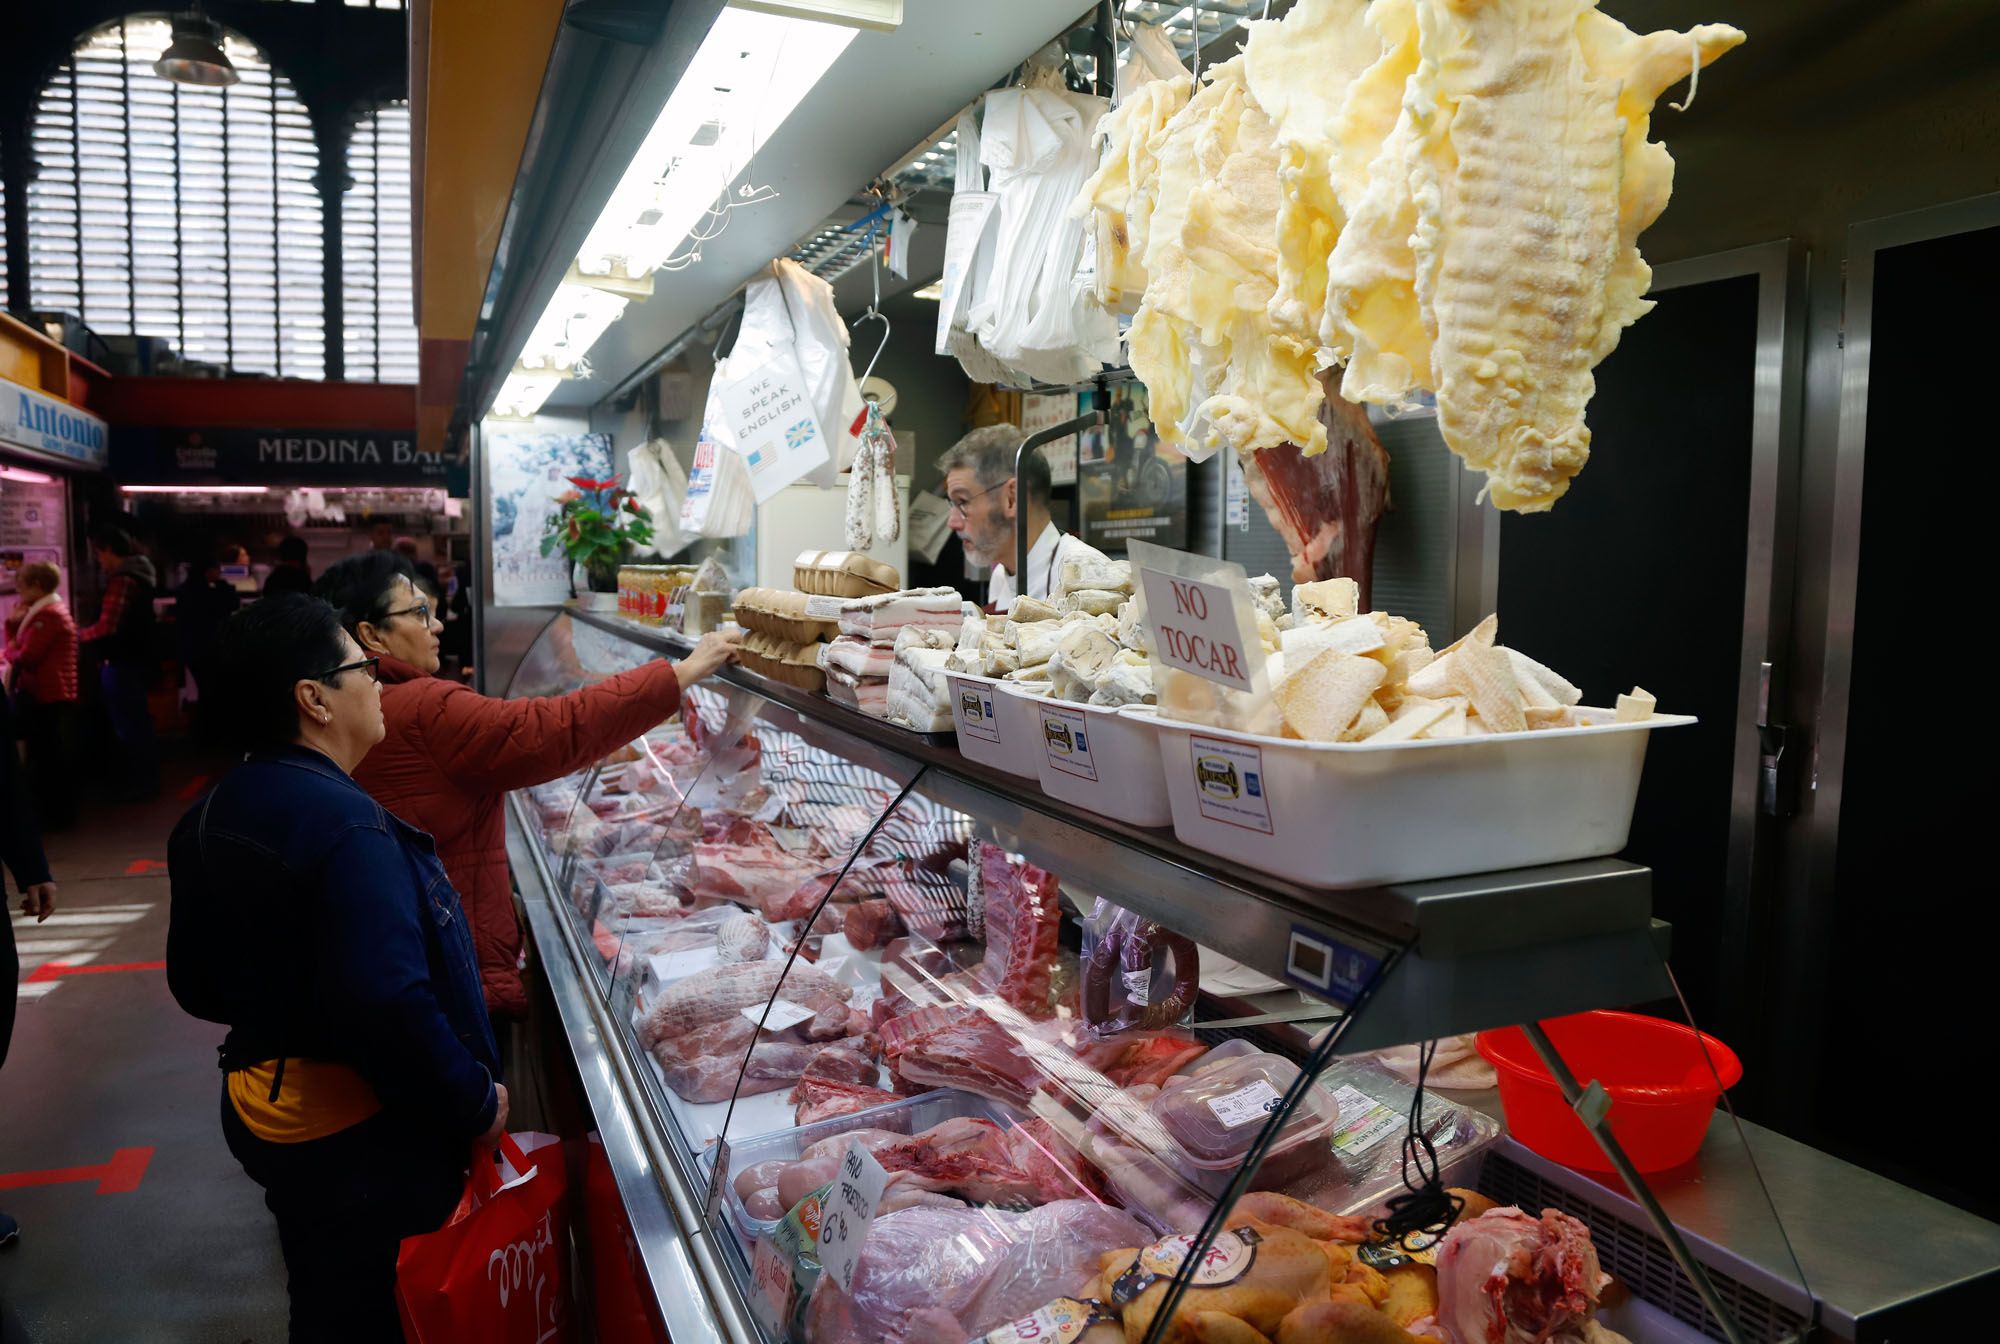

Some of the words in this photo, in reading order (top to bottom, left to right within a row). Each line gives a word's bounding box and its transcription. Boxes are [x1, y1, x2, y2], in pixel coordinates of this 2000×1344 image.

[741, 383, 791, 419] SPEAK
[749, 378, 771, 396] WE
[18, 391, 103, 450] Antonio
[739, 394, 802, 440] ENGLISH
[257, 438, 382, 465] MEDINA
[1169, 579, 1208, 621] NO
[1160, 624, 1246, 681] TOCAR
